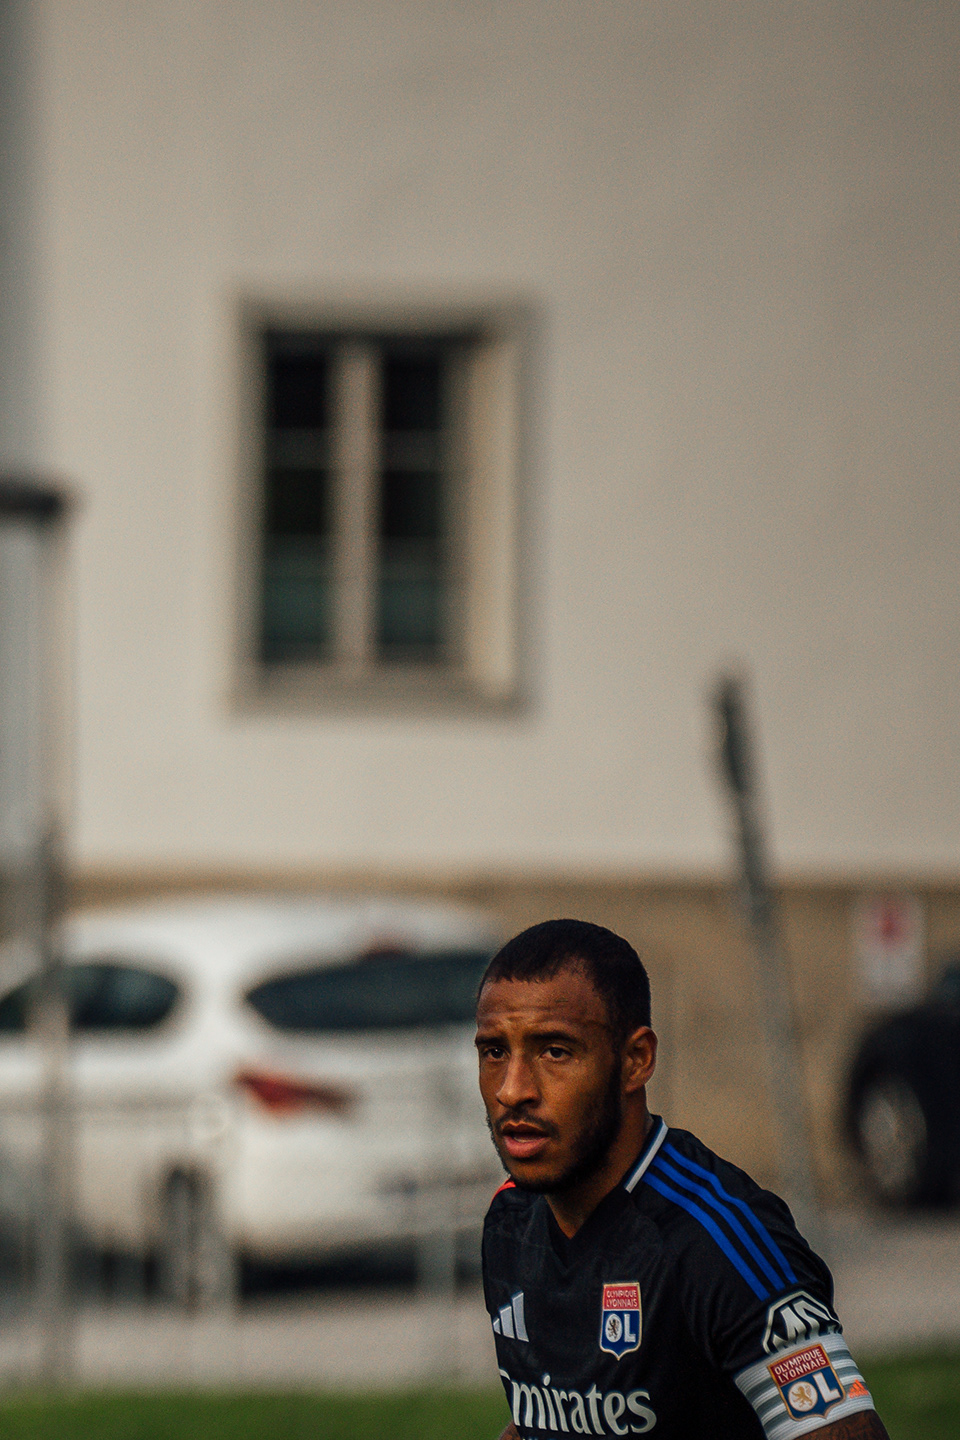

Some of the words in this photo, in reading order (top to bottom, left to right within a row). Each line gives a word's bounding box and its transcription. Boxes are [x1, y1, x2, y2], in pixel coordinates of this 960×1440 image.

[606, 1289, 637, 1298] OLYMPIQUE
[606, 1299, 638, 1308] LYONNAIS
[605, 1313, 636, 1342] OL
[774, 1348, 822, 1375] OLYMPIQUE
[778, 1356, 827, 1383] LYONNAIS
[499, 1368, 657, 1436] mirates
[788, 1372, 841, 1412] OL
